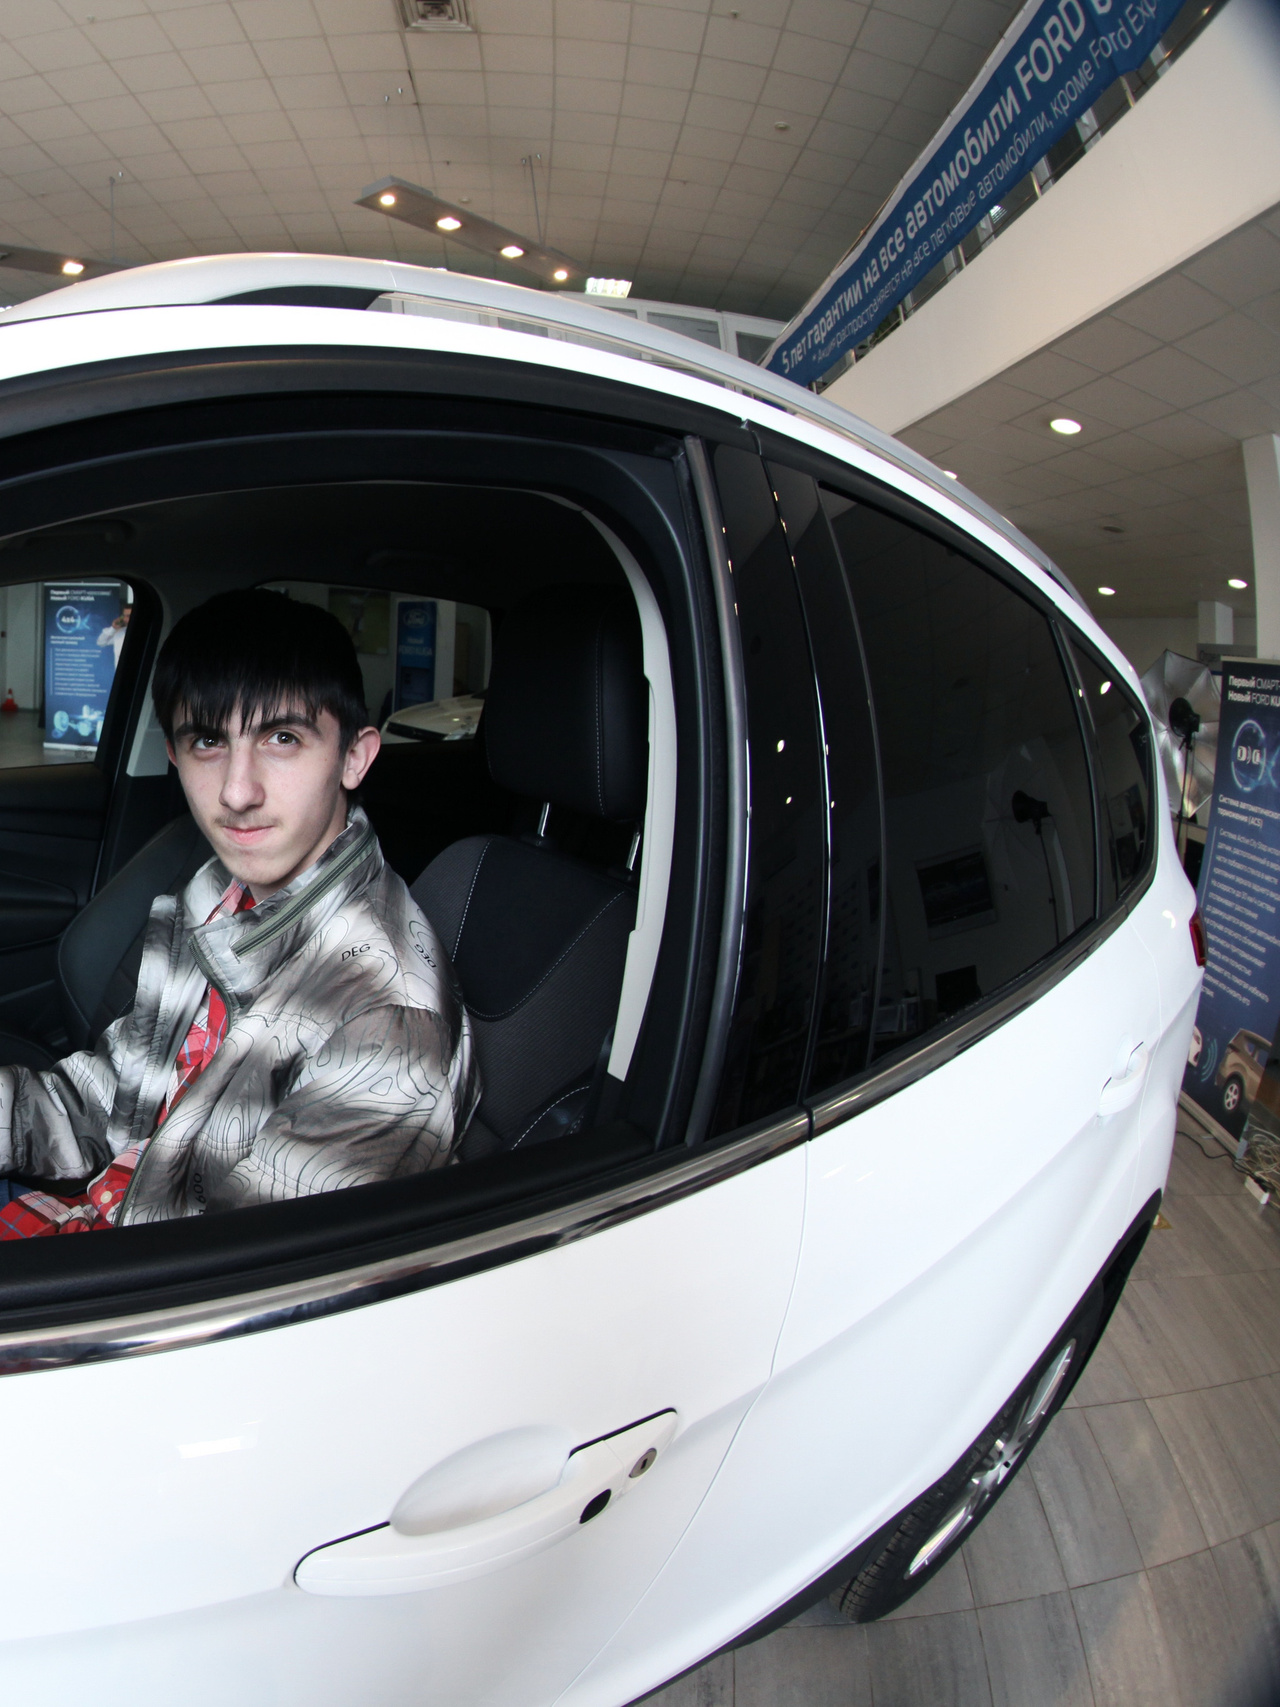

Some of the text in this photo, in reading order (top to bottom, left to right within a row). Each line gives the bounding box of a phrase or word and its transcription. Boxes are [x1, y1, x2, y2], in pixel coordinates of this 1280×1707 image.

[901, 259, 914, 280] на
[913, 241, 931, 268] все
[930, 190, 977, 251] легковые
[977, 111, 1054, 199] автомобили,
[1050, 60, 1095, 119] кроме
[1088, 18, 1132, 69] Ford
[782, 0, 1086, 374] 5 лет гарантии на все автомобили FORD
[1228, 675, 1256, 688] Первый
[1228, 690, 1251, 703] Новый
[1251, 693, 1270, 706] FORD
[341, 943, 371, 961] DEG
[414, 944, 437, 968] DEG
